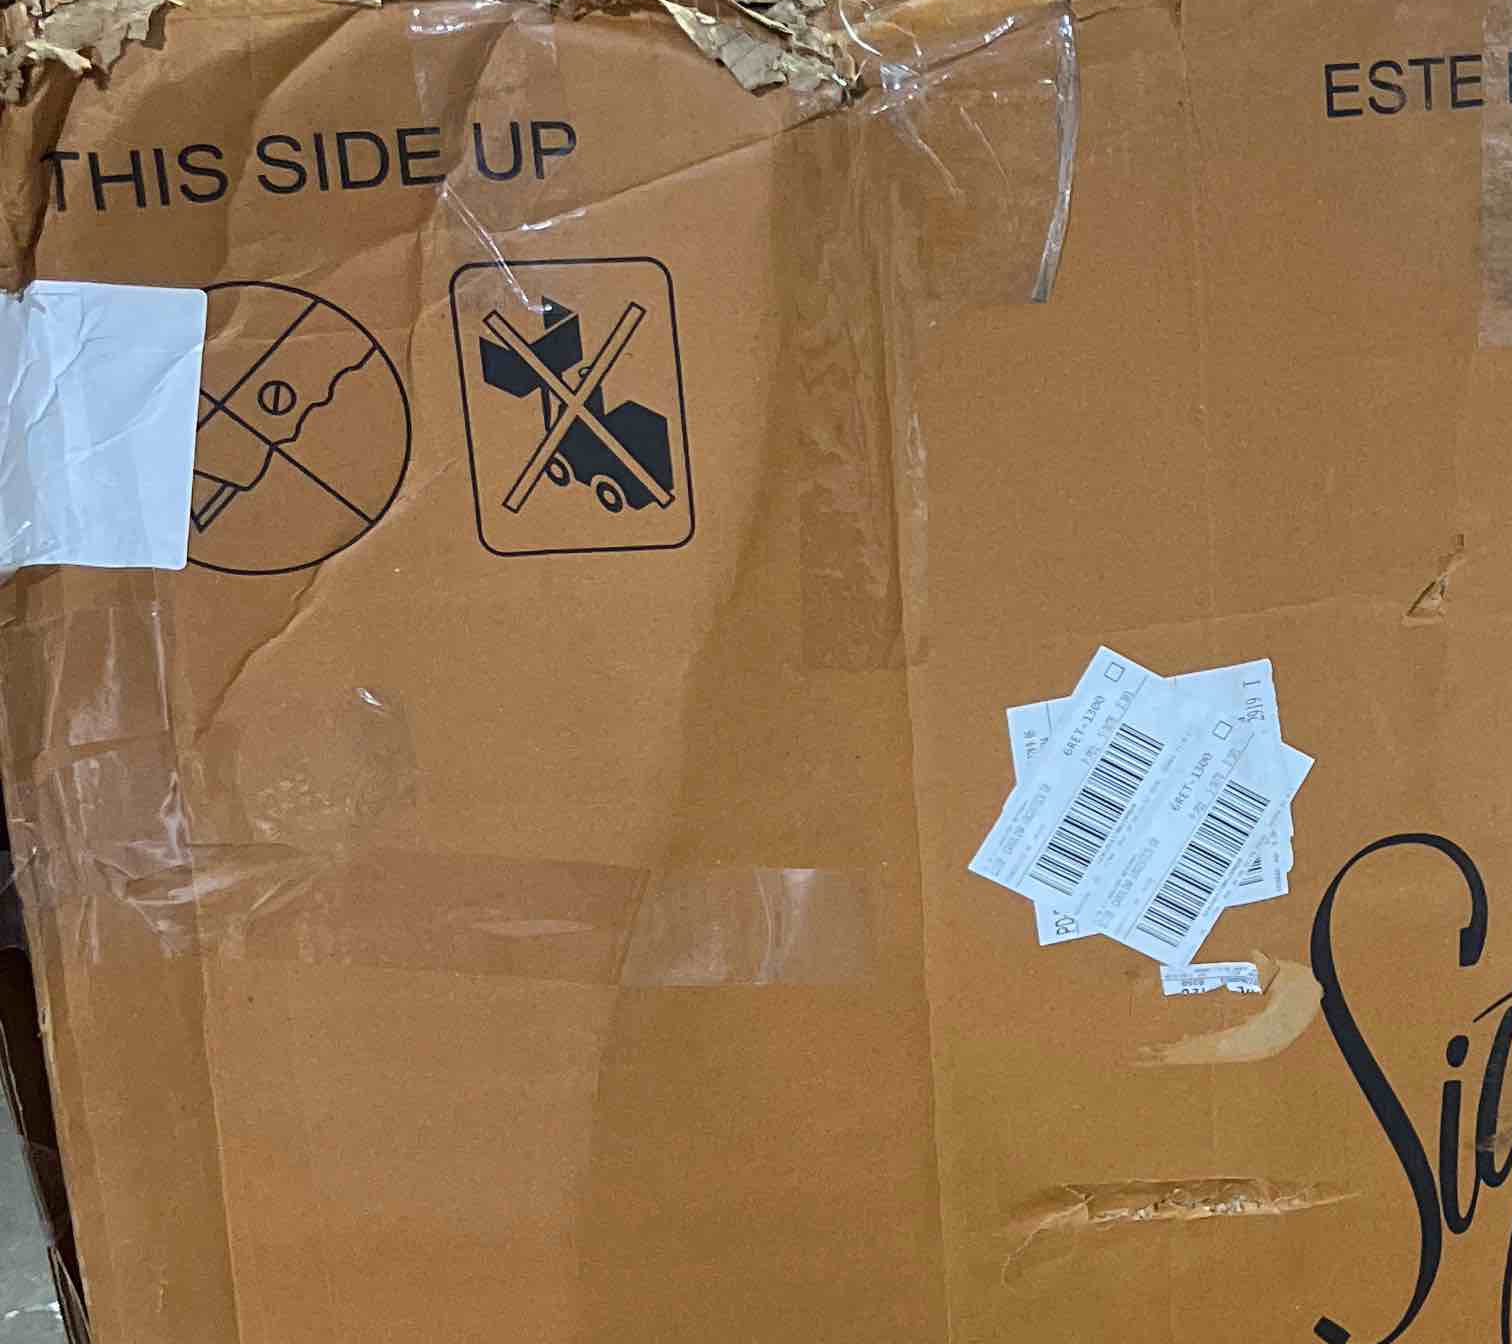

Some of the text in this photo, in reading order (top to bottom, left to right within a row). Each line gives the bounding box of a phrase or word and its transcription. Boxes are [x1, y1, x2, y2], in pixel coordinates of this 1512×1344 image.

[1323, 53, 1485, 118] ESTE
[43, 119, 578, 213] THIS SIDE UP
